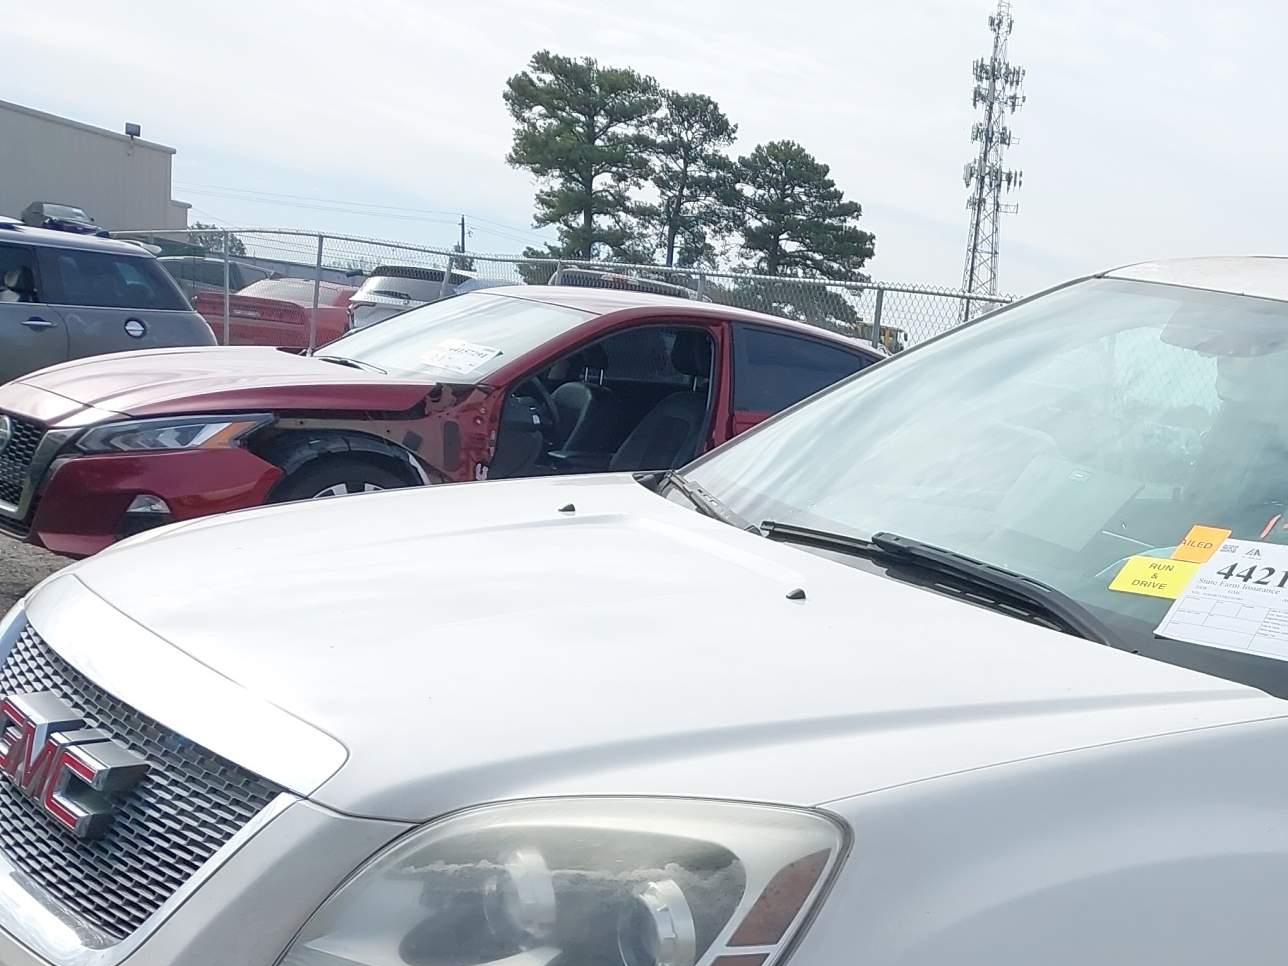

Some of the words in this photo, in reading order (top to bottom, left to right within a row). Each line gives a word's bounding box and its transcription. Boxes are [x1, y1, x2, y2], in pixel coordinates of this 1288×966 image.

[1148, 562, 1175, 573] RUN
[1150, 571, 1159, 580] &
[1131, 578, 1167, 591] DRIVE
[1198, 577, 1218, 586] State
[1219, 580, 1241, 590] Farm
[1241, 583, 1281, 595] Insurance
